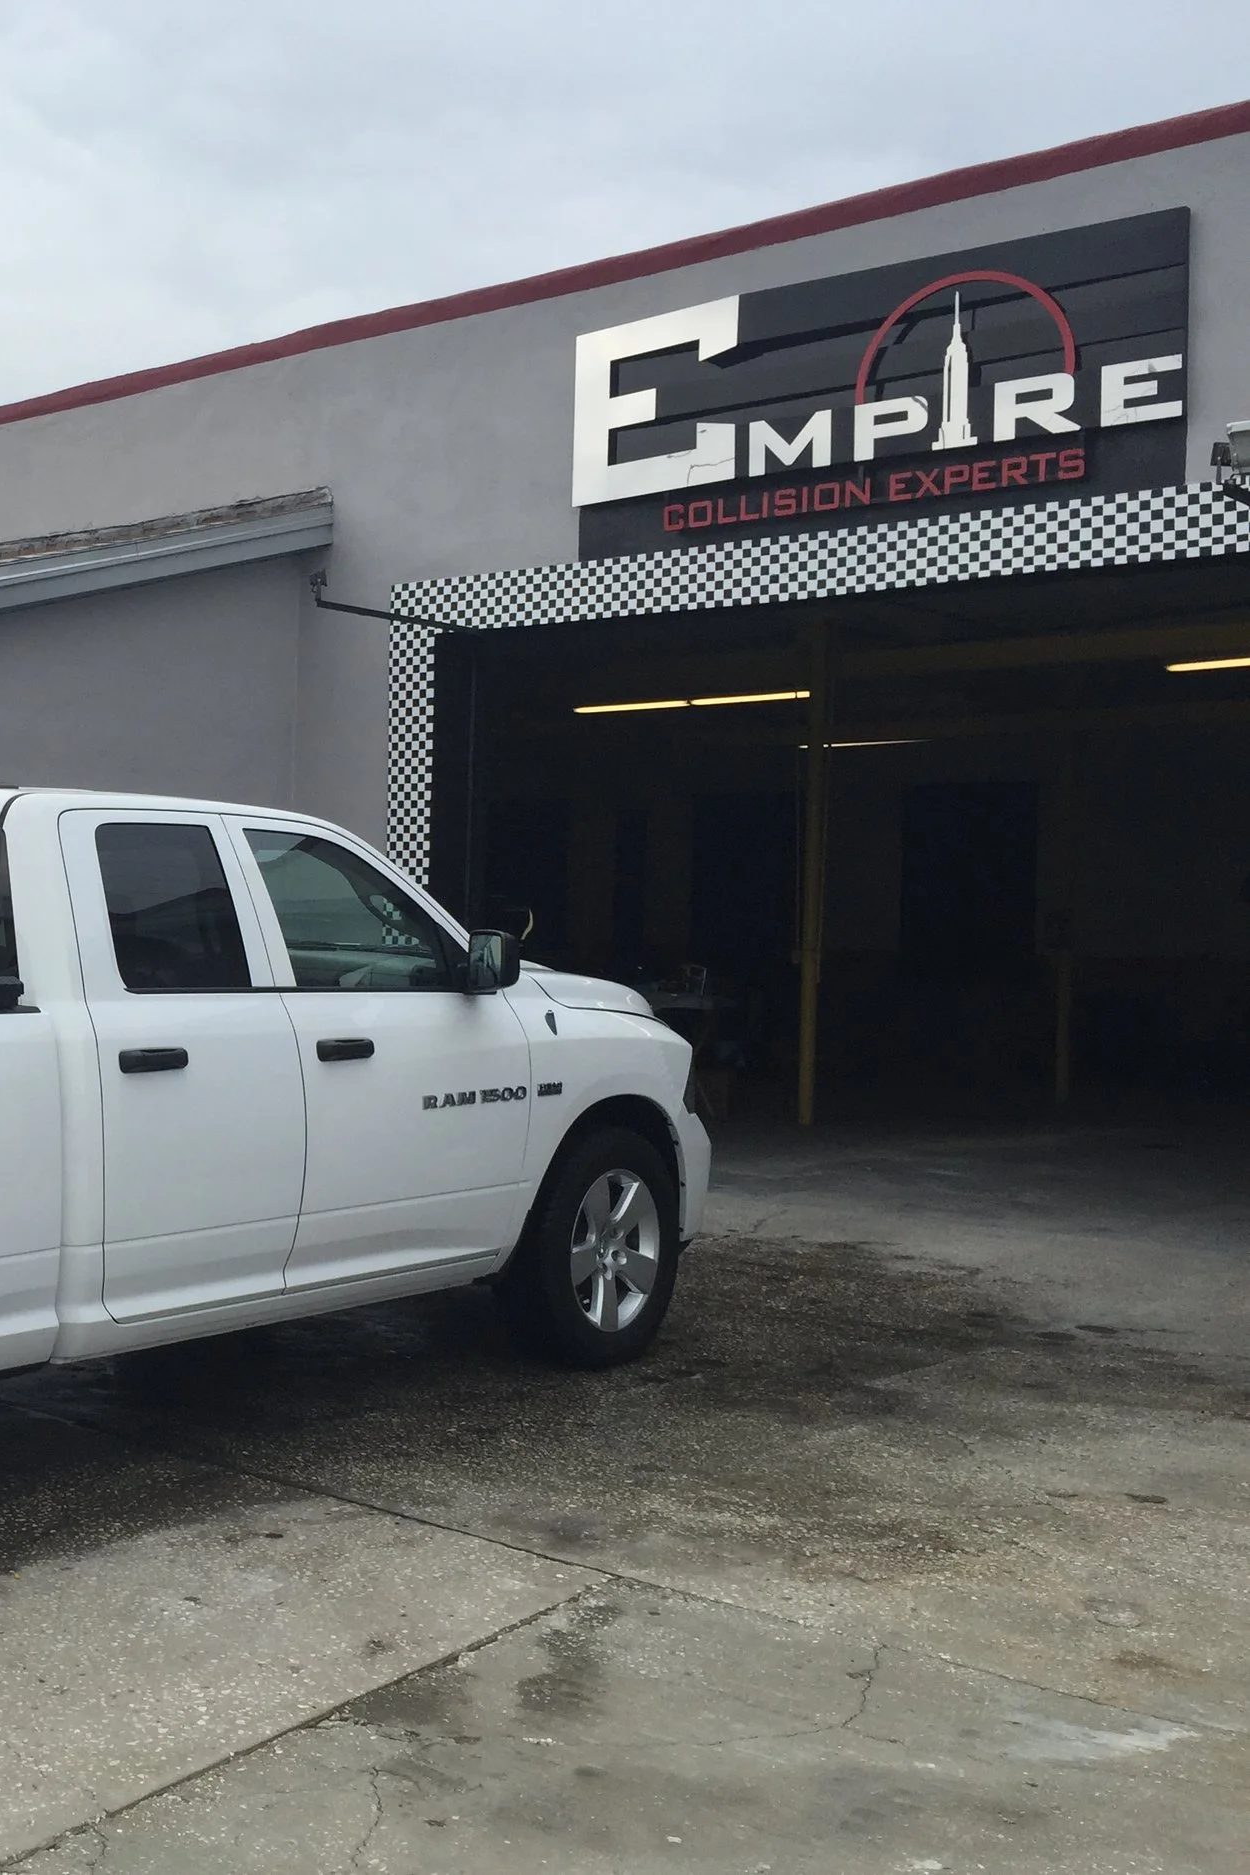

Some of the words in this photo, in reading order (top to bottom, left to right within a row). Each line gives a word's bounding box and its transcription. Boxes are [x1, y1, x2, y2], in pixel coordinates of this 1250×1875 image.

[572, 291, 1183, 507] EMPIRE
[663, 477, 871, 532] COLLISION
[889, 448, 1086, 501] EXPERTS
[422, 1091, 477, 1110] RAM
[479, 1086, 527, 1104] 1500
